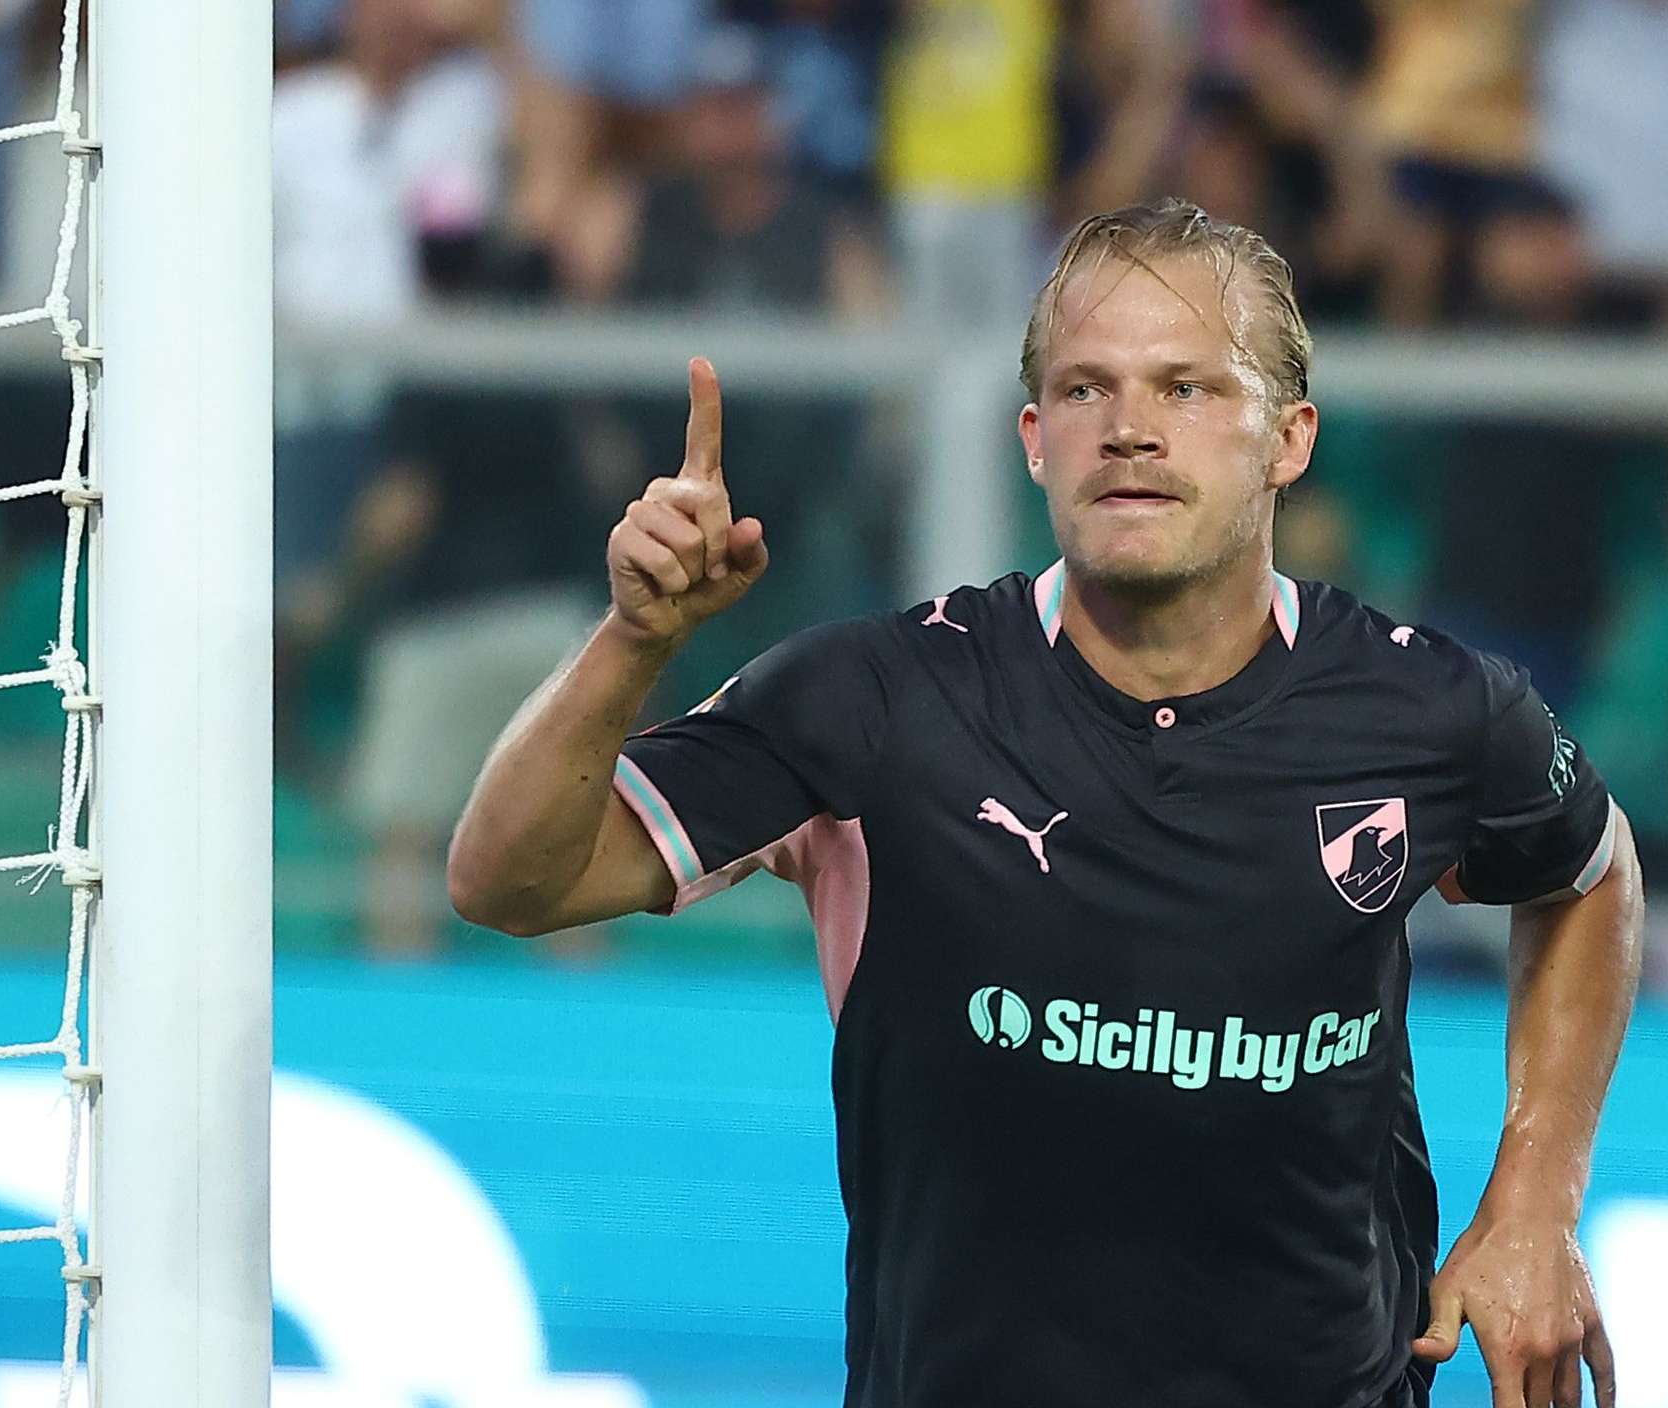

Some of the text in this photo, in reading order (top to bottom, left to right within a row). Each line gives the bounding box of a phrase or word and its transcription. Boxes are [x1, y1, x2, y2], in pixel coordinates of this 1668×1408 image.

[1041, 998, 1382, 1093] Sicily by Car
